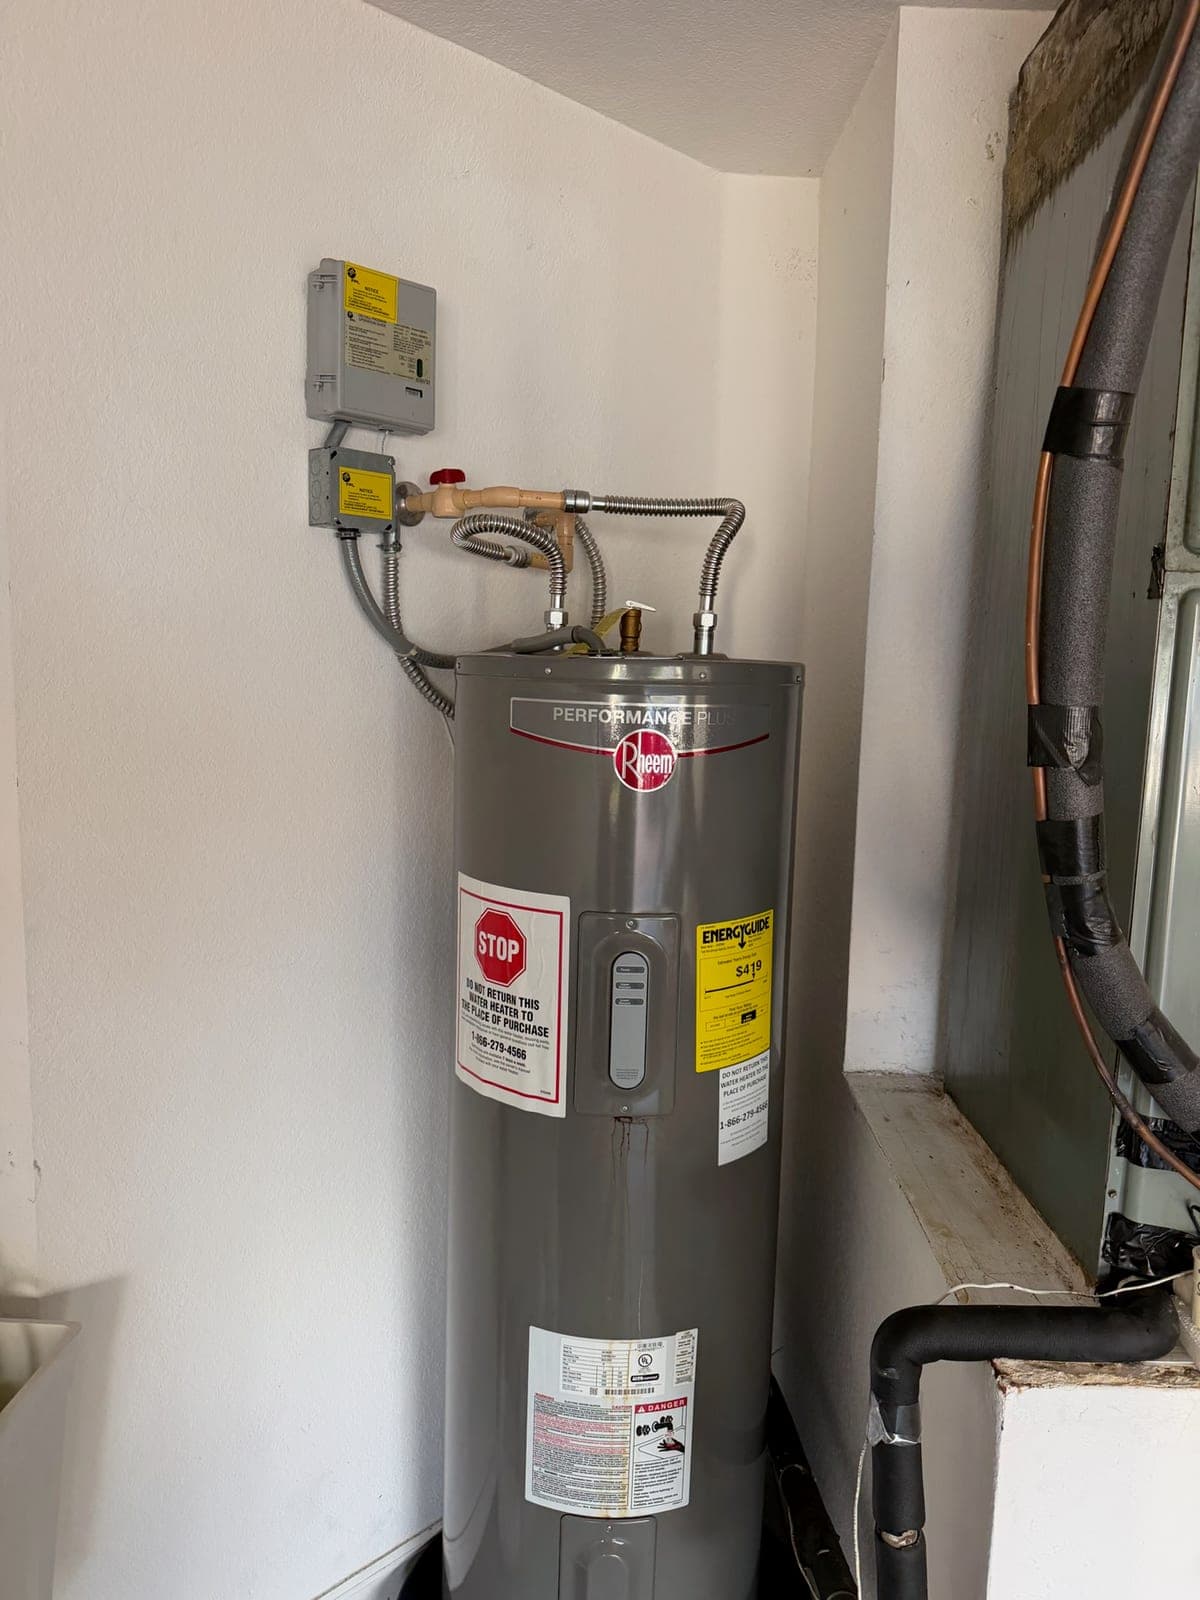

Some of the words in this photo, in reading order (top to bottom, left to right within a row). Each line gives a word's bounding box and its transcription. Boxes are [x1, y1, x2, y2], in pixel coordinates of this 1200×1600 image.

[552, 706, 692, 725] PERFORMANCE
[622, 741, 673, 784] Rheem
[478, 931, 520, 963] STOP
[466, 978, 474, 990] DO
[474, 981, 486, 995] NOT
[487, 987, 517, 1006] RETURN
[518, 997, 540, 1011] THIS
[469, 991, 488, 1010] WATER
[490, 1000, 519, 1020] HEATER
[521, 1010, 534, 1022] TO
[461, 998, 471, 1013] THE
[471, 1004, 490, 1022] PLACE
[491, 1014, 502, 1026] OF
[503, 1018, 549, 1038] PURCHASE
[471, 1031, 527, 1060] 1-866-279-4566
[722, 1071, 731, 1079] DO
[732, 1068, 742, 1077] NOT
[723, 1086, 739, 1097] PLACE
[647, 1399, 686, 1411] DANGER
